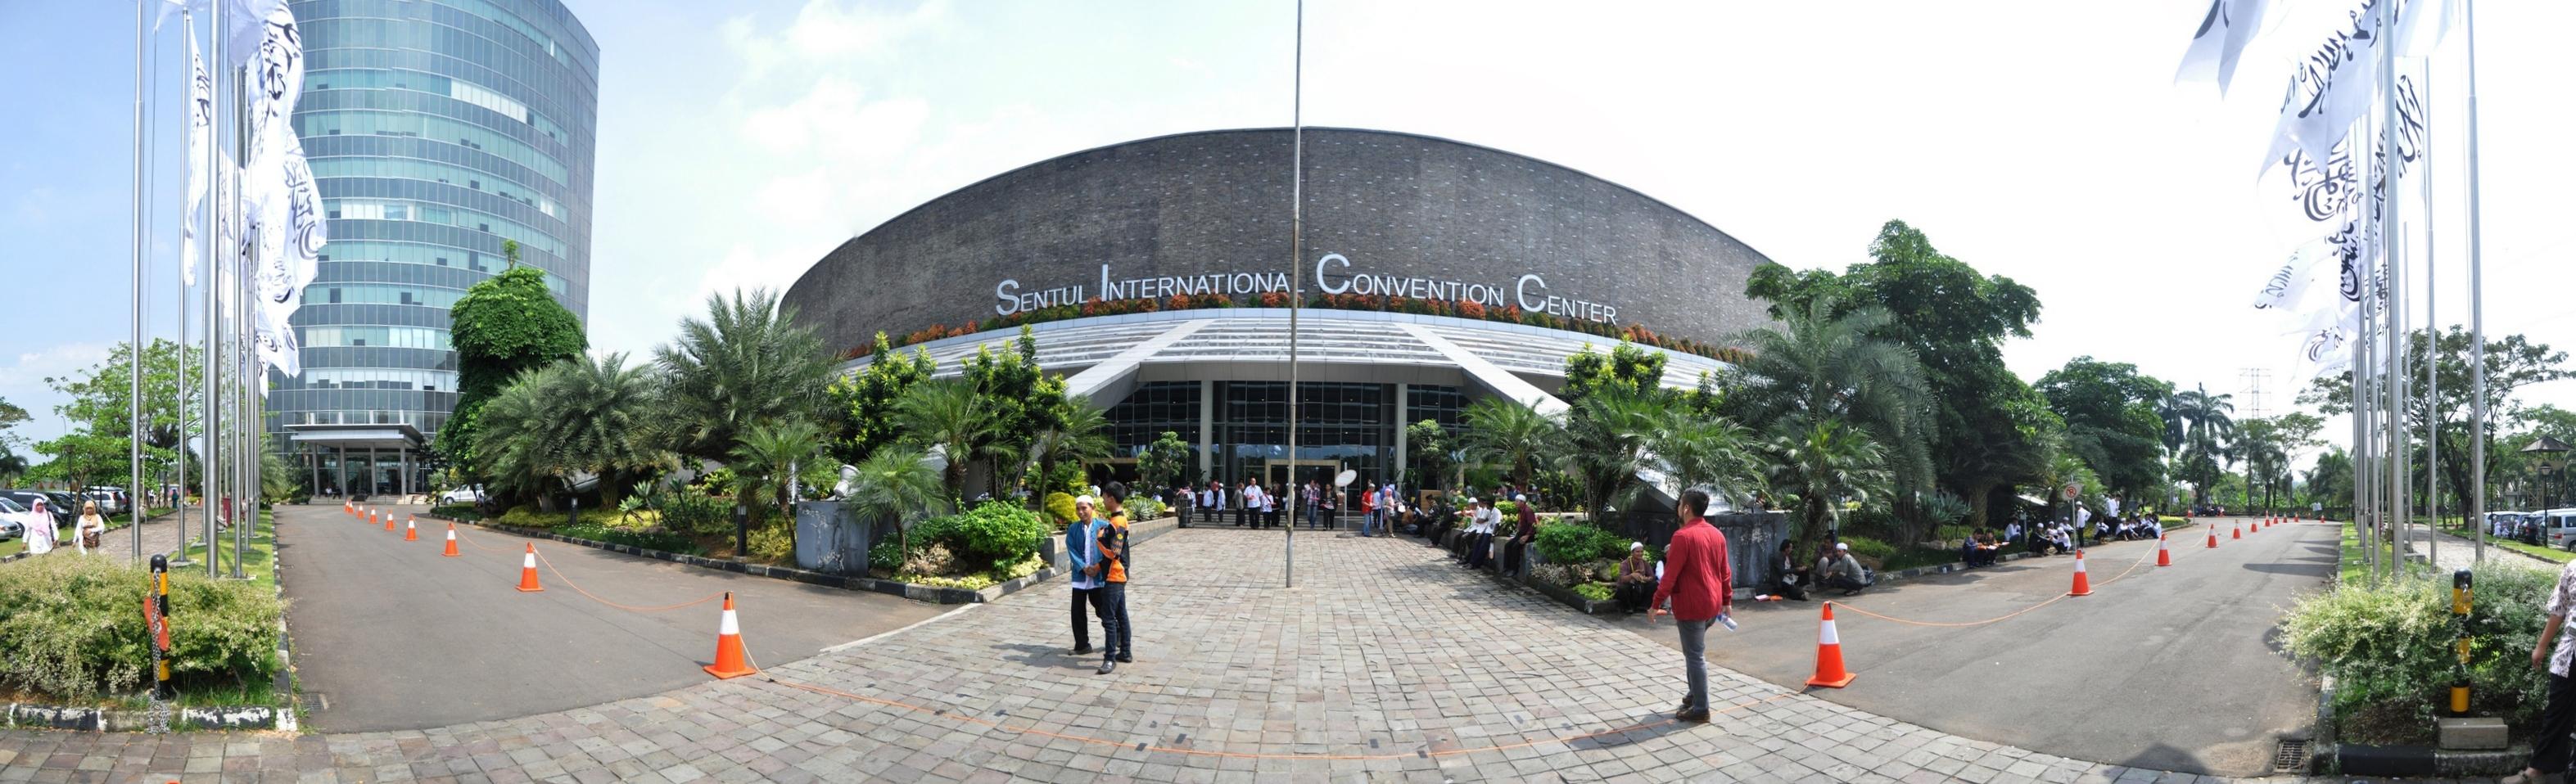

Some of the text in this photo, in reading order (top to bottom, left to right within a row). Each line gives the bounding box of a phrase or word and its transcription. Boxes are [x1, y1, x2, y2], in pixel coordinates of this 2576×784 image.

[996, 279, 1089, 316] SENTUL
[1316, 253, 1504, 307] CONVENTION
[1517, 274, 1616, 326] CENTER
